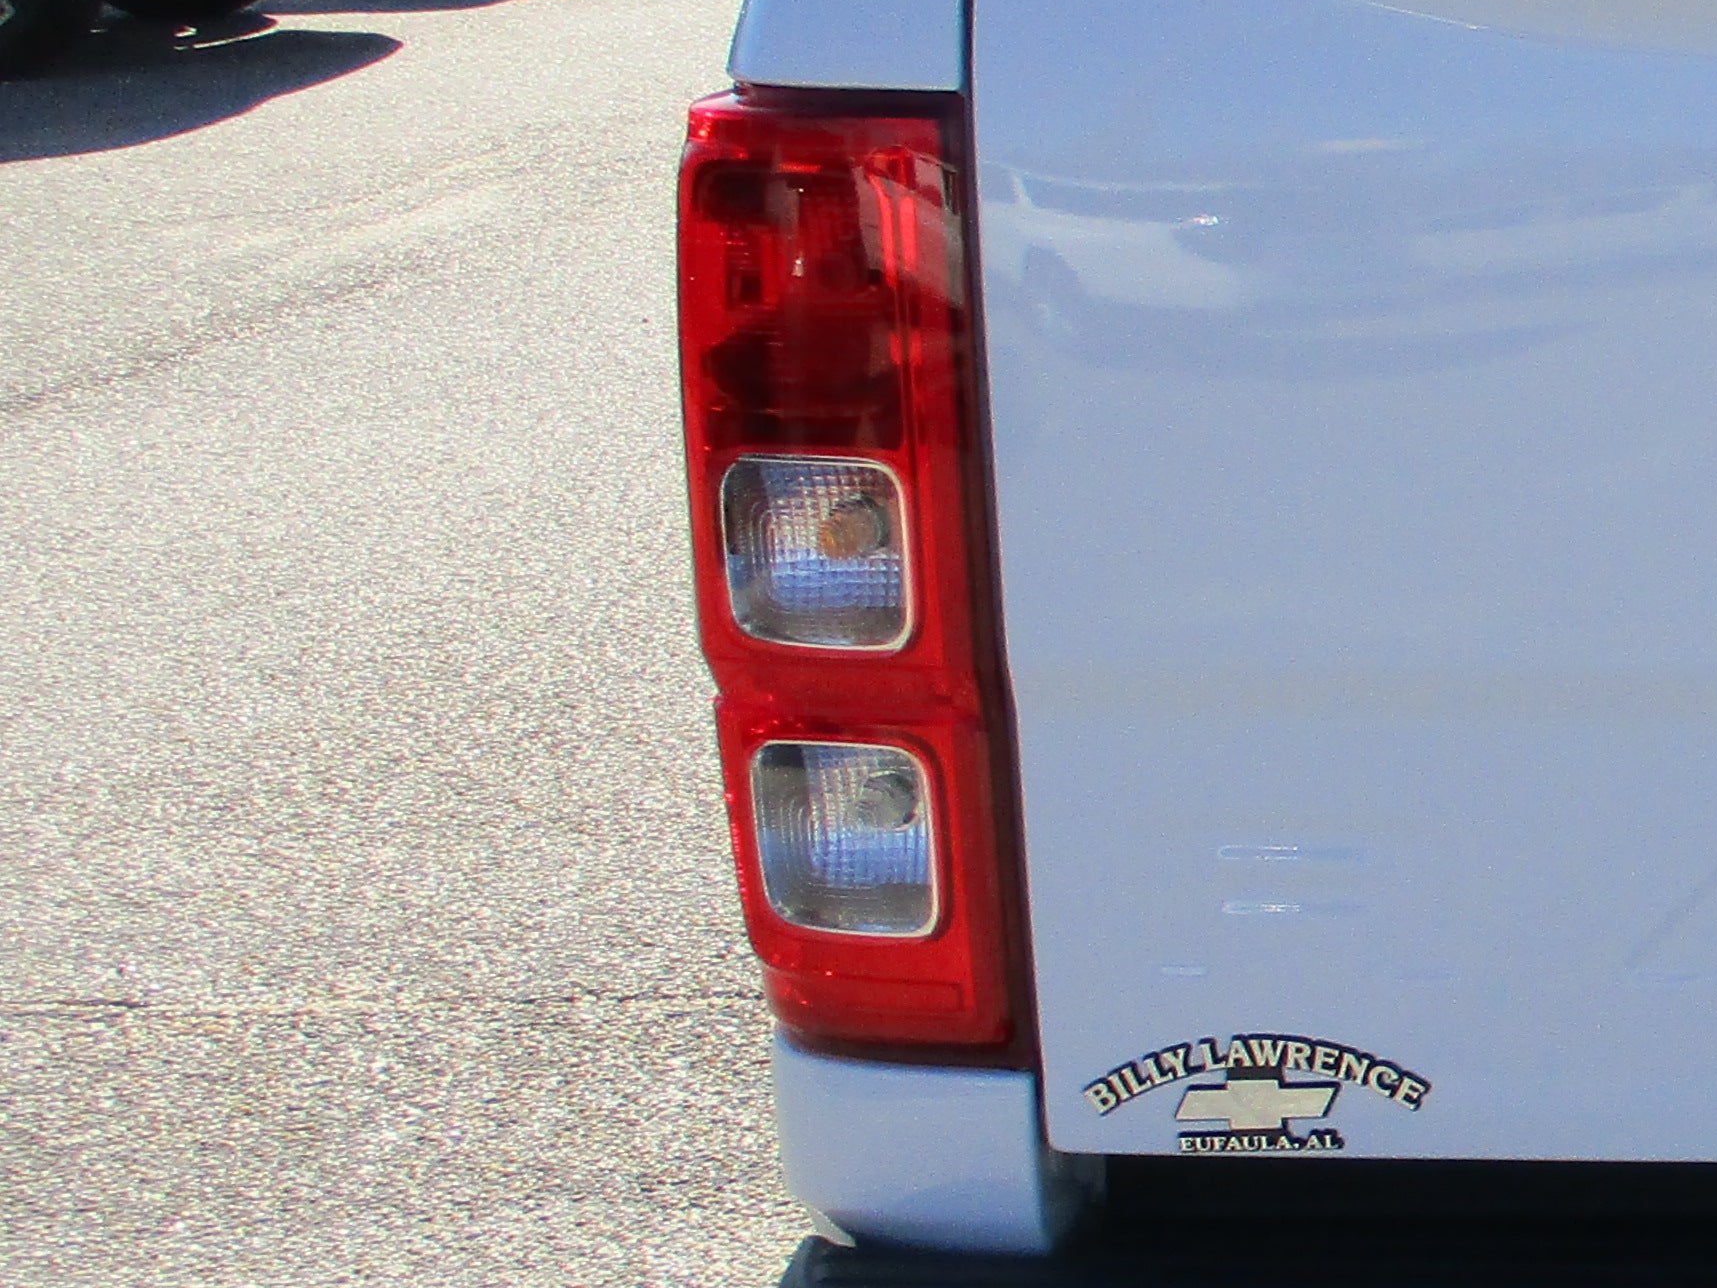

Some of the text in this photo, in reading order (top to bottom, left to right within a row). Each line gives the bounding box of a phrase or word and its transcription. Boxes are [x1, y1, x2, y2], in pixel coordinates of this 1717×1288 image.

[1083, 1037, 1430, 1115] BILLY LAWRENCE
[1305, 1134, 1340, 1151] AL
